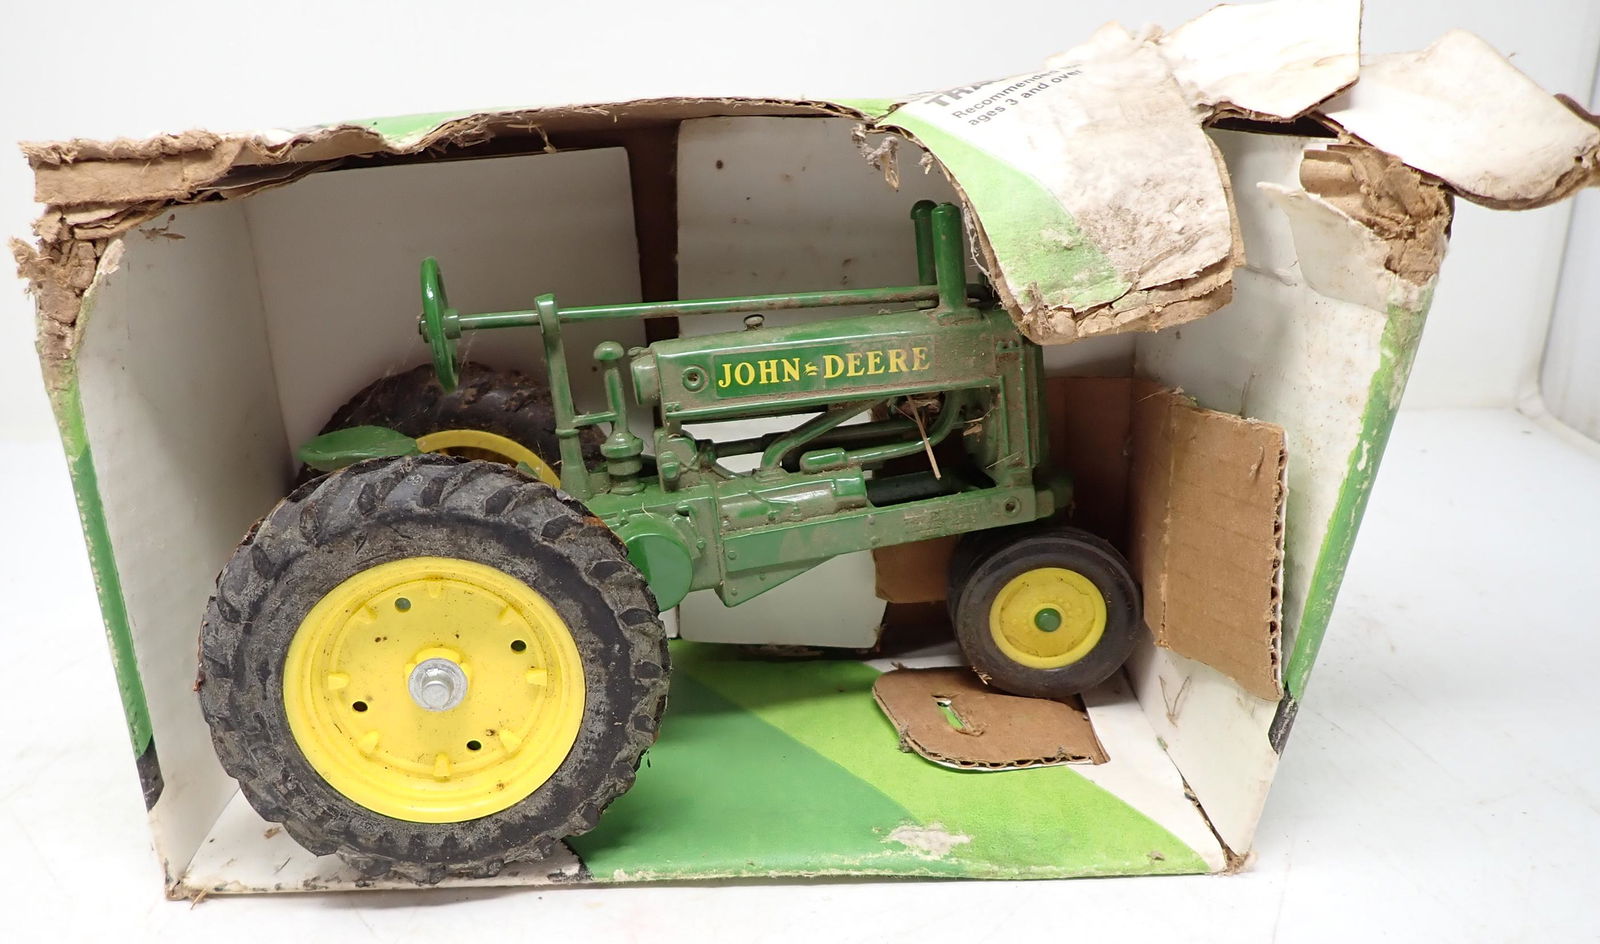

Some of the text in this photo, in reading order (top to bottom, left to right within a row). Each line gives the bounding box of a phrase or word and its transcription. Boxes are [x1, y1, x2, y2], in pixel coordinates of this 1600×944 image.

[968, 69, 1083, 127] ages 3 and over
[718, 346, 930, 388] JOHN DEERE
